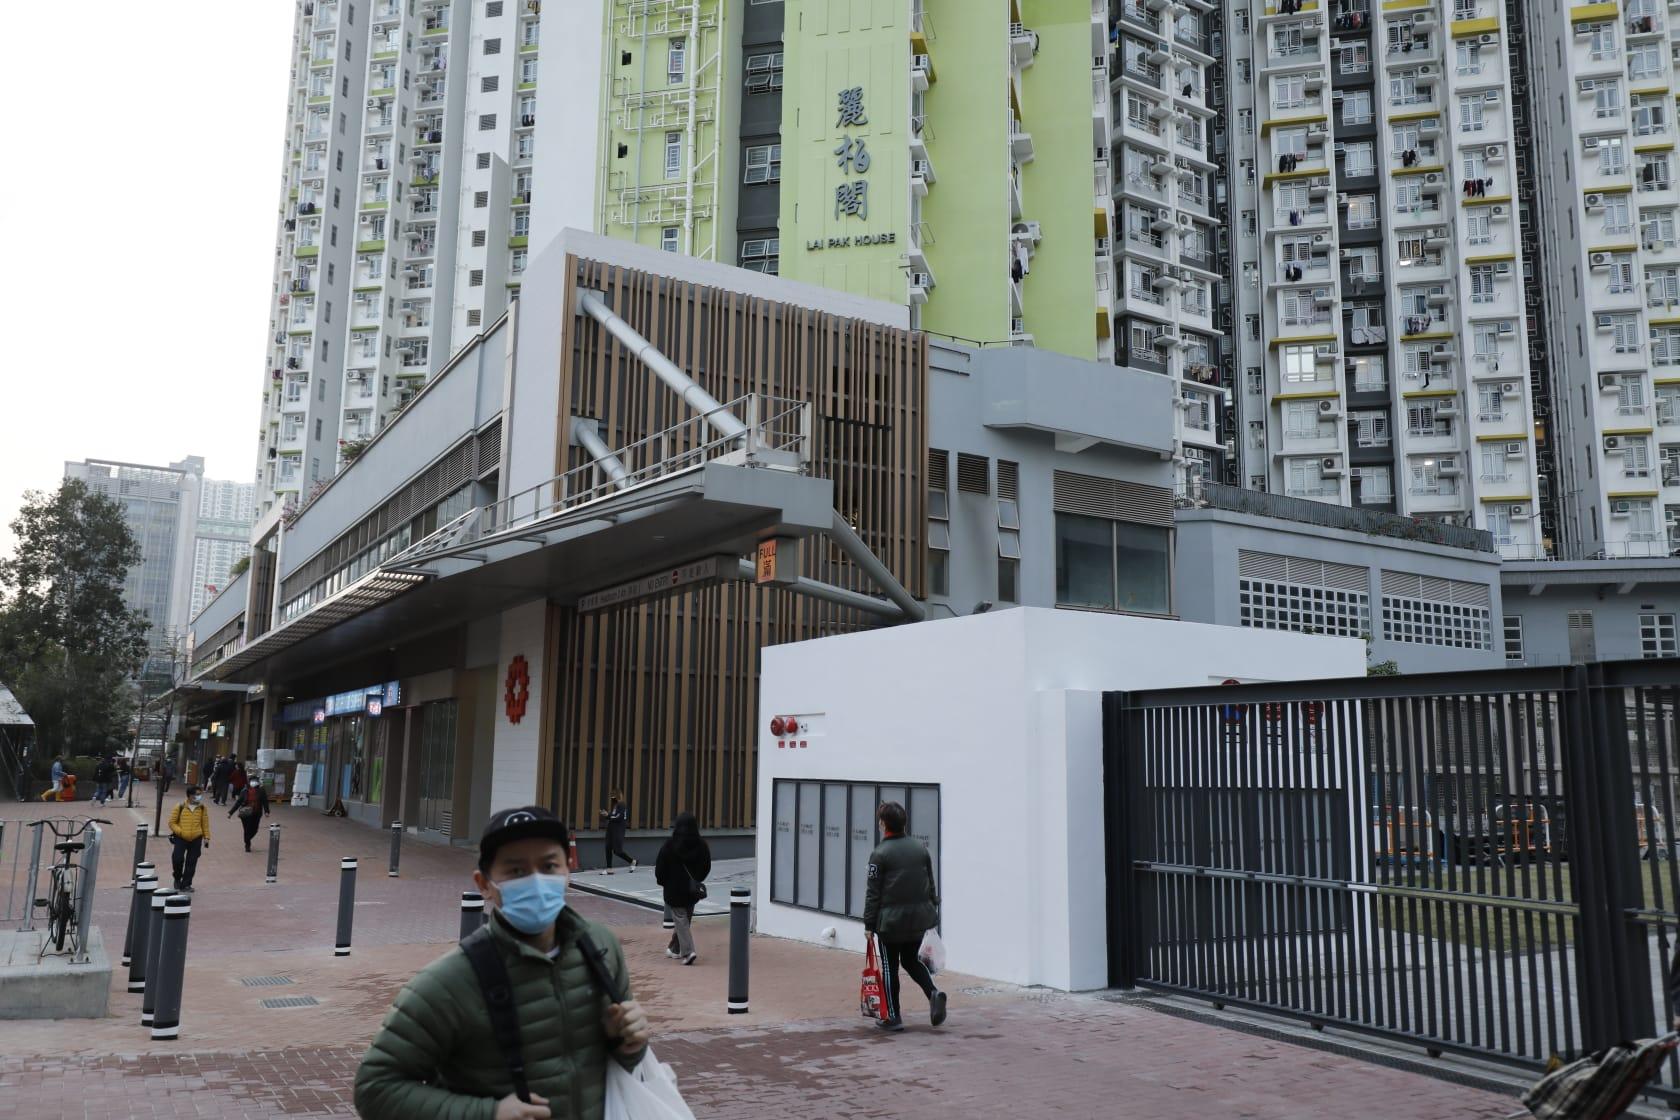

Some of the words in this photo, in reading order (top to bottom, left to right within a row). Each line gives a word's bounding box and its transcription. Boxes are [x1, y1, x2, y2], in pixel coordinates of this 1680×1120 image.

[834, 86, 871, 222] 麗柏閣
[806, 239, 824, 251] LAI
[828, 236, 851, 249] PAK
[854, 232, 896, 247] HOUSE
[760, 545, 777, 560] FULL
[763, 559, 772, 577] 滿
